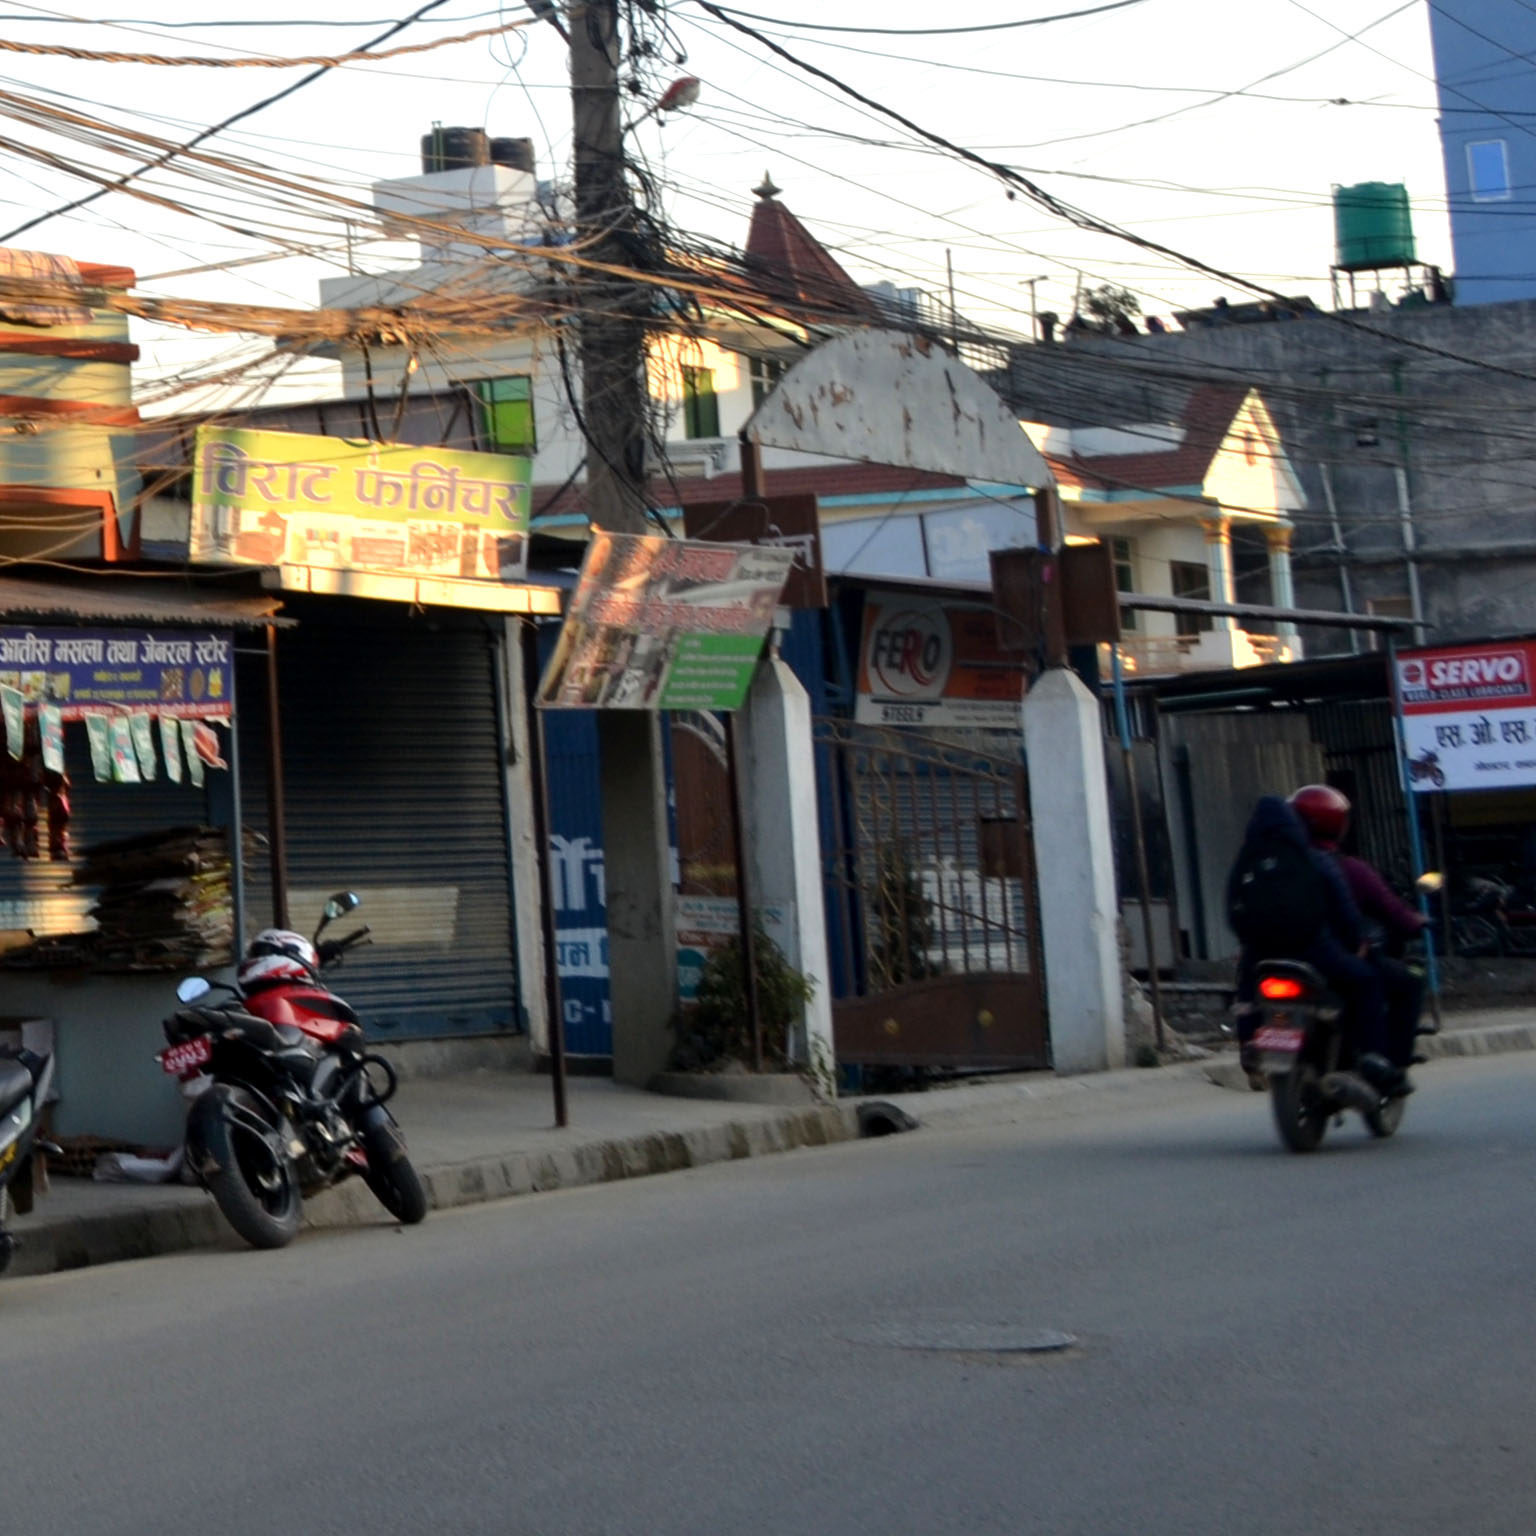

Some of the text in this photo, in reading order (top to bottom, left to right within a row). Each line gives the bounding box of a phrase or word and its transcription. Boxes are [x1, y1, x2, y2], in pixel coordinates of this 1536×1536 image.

[201, 440, 528, 522] विराट फर्निचर
[106, 639, 137, 665] तथा
[141, 633, 192, 665] जेनरल
[194, 633, 228, 665] स्टोर
[1429, 656, 1521, 687] SERVO
